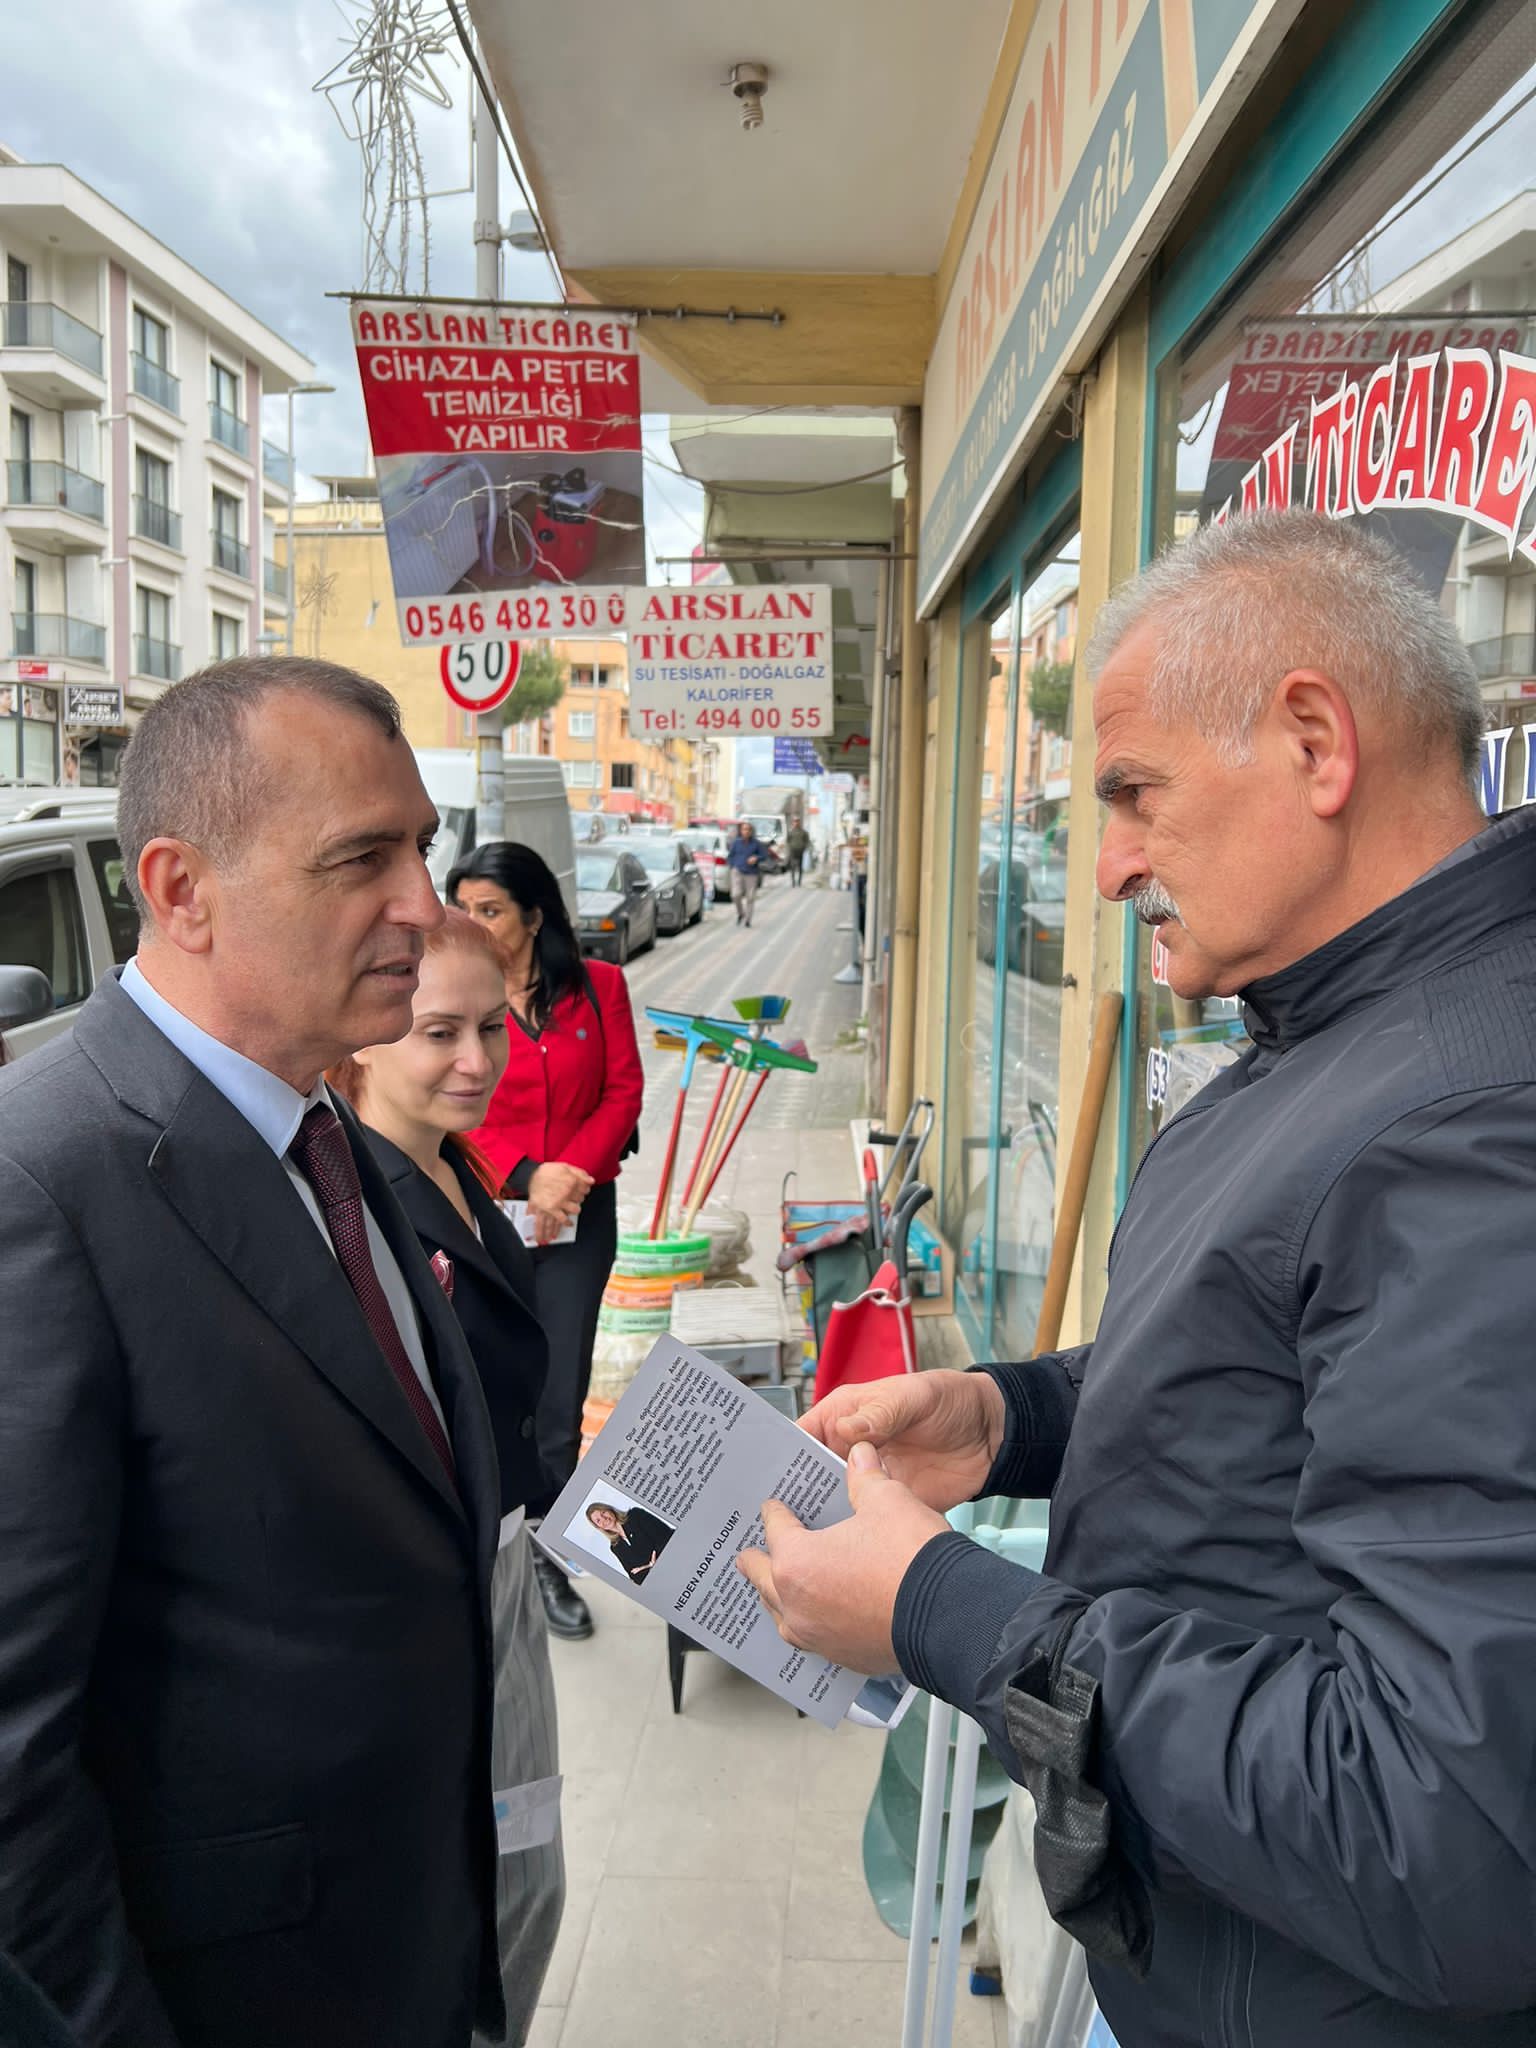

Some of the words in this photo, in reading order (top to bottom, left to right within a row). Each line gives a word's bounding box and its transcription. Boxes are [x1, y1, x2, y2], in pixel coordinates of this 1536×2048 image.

[954, 0, 1068, 424] ARSLAN
[1027, 89, 1137, 378] DOĞALGAZ
[360, 311, 487, 345] ARSLAN
[500, 316, 633, 351] TİCARET
[370, 349, 512, 383] CİHAZLA
[522, 357, 629, 385] PETEK
[423, 387, 583, 418] TEMİZLİĞİ
[446, 424, 569, 450] YAPILIR
[405, 606, 485, 639] 0546
[496, 599, 551, 631] 482
[641, 592, 814, 621] ARSLAN
[634, 626, 824, 661] TİCARET
[456, 641, 505, 684] 50
[634, 668, 656, 681] SU
[659, 664, 727, 681] TESİSATI
[739, 662, 825, 681] DOĞALGAZ
[686, 684, 774, 702] KALORİFER
[639, 709, 686, 731] Tel:
[695, 708, 742, 730] 494
[750, 708, 782, 729] 00
[790, 707, 821, 729] 55
[624, 1426, 637, 1442] Olur
[633, 1418, 653, 1444] Anadolu
[624, 1465, 644, 1490] Türkiye
[644, 1438, 661, 1460] Büyük
[673, 1576, 700, 1611] NEDEN
[694, 1549, 717, 1578] ADAY
[711, 1510, 741, 1551] OLDUM?
